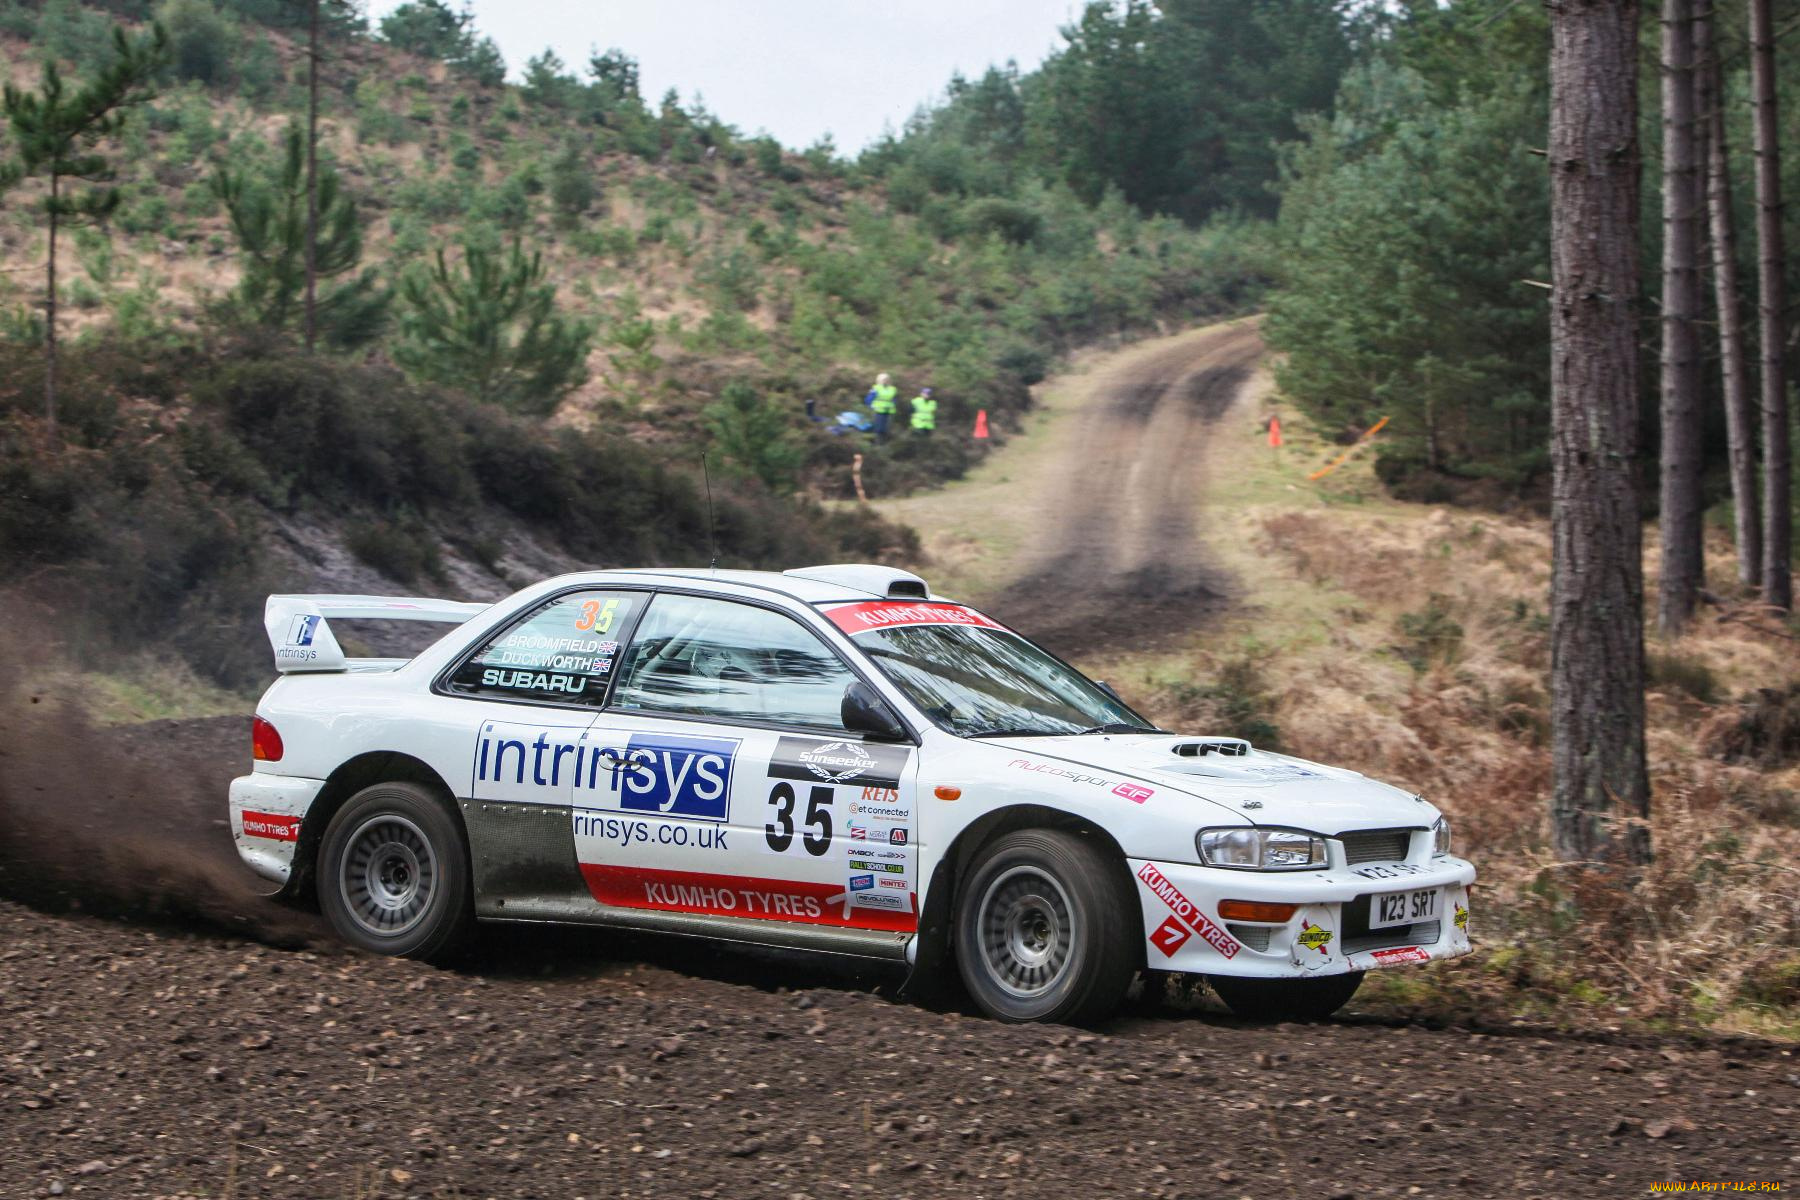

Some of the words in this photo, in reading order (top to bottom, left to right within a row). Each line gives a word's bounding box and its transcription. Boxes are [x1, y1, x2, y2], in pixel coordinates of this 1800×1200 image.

[576, 599, 621, 635] 35
[854, 607, 925, 625] KUMHO
[920, 608, 976, 623] TYRES
[507, 635, 598, 653] BROOMFIELD
[276, 649, 317, 661] intrinsys
[501, 651, 593, 670] DUCKWORTH
[482, 669, 587, 693] SUBARU
[479, 724, 725, 812] intrinsys
[799, 751, 878, 768] Sunseeker
[861, 786, 898, 802] REIS
[765, 781, 834, 857] 35
[867, 807, 909, 817] connected
[266, 823, 289, 836] TYRES
[574, 811, 728, 850] rinsys.co.uk
[644, 882, 736, 910] KUMHO
[740, 890, 821, 918] TYRES
[1411, 890, 1437, 918] SRT
[1139, 865, 1192, 917] KUMHO
[1190, 912, 1238, 957] TYRES
